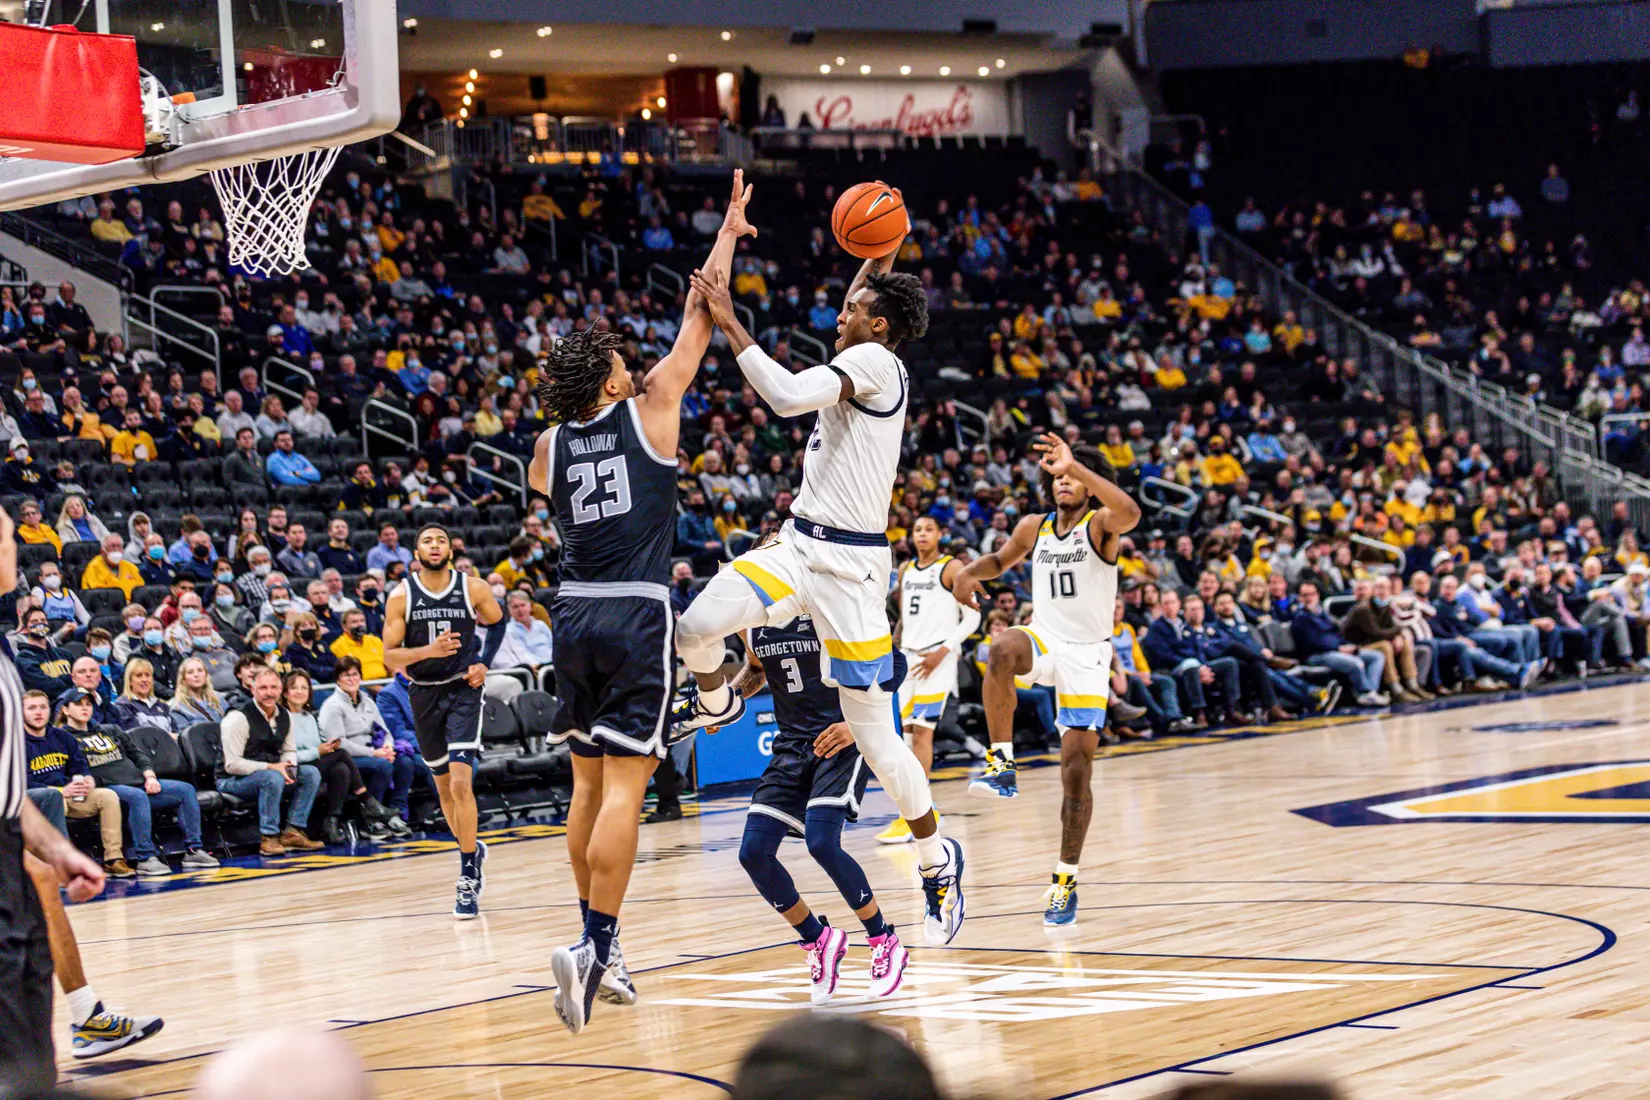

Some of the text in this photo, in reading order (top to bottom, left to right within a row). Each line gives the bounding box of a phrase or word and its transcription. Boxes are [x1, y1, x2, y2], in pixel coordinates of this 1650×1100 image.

[568, 433, 618, 457] HOLLOWAY
[566, 454, 632, 525] 23
[1036, 548, 1088, 568] Marquette
[1049, 569, 1078, 599] 10
[412, 607, 466, 620] GEORGETOWN
[909, 595, 921, 616] 5
[754, 640, 820, 658] GEORGETOWN
[780, 657, 804, 693] 3
